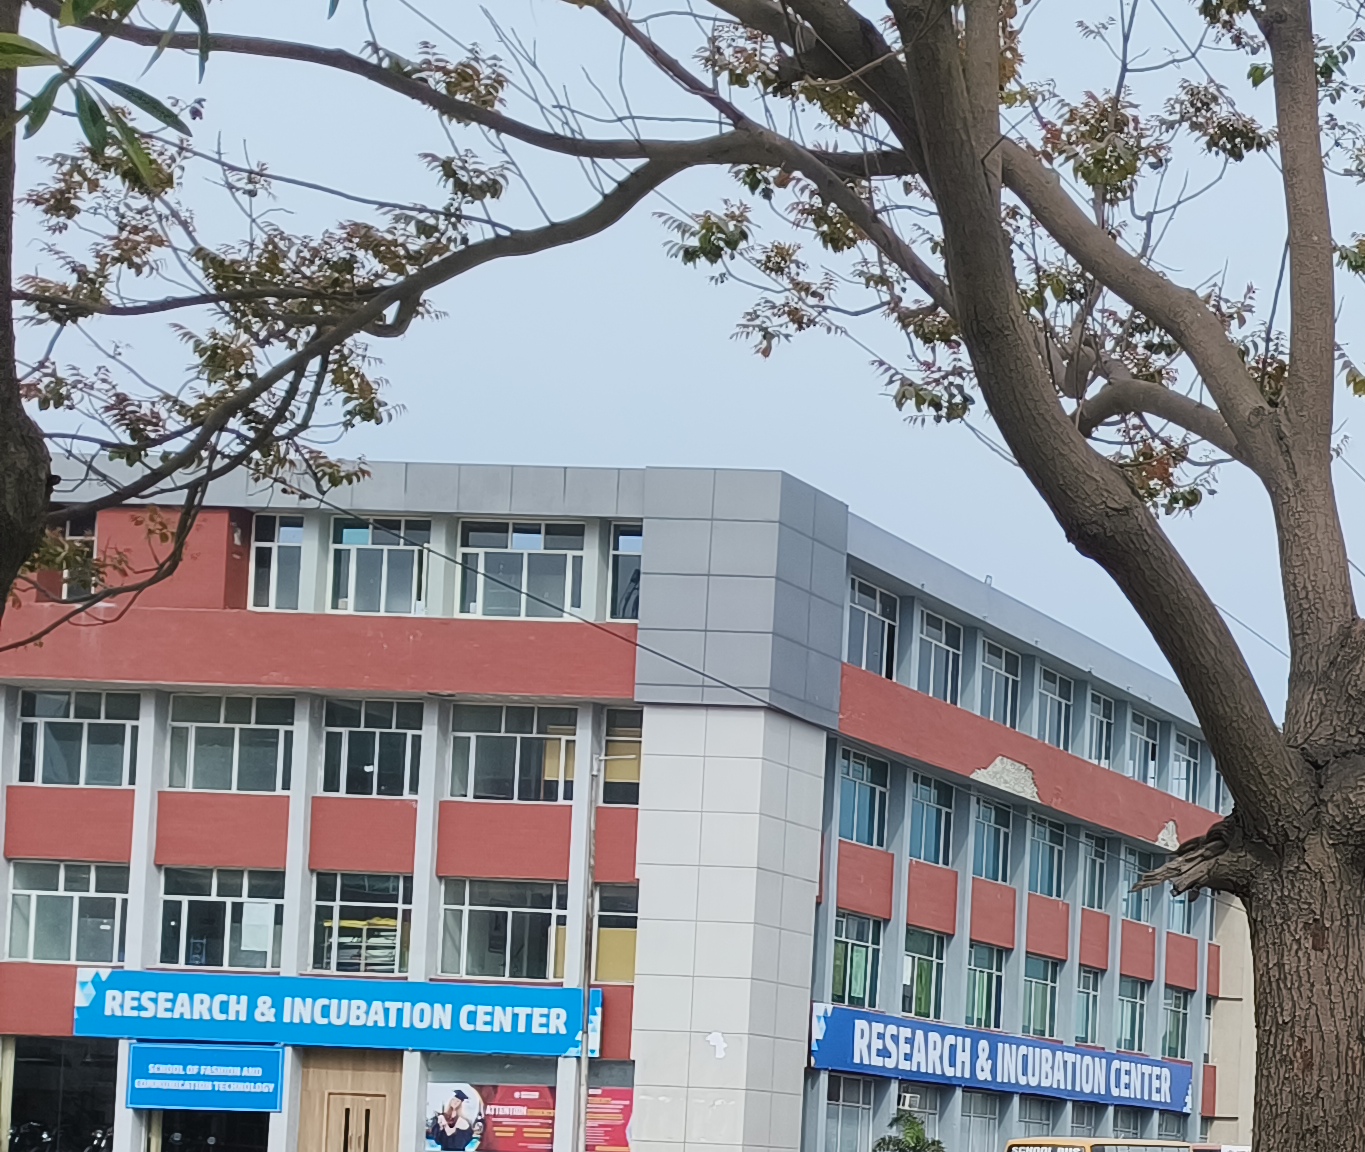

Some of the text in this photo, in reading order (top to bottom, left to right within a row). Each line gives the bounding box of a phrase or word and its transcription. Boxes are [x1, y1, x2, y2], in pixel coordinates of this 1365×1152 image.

[104, 990, 567, 1034] RESEARCH & INCUBATION CENTER
[148, 1063, 184, 1075] SCHOOL
[186, 1064, 199, 1075] OF
[242, 1066, 262, 1077] AND
[853, 1019, 1171, 1103] RESEARCH & INCUBATION CENTER
[213, 1080, 274, 1092] TECHNOLOGY
